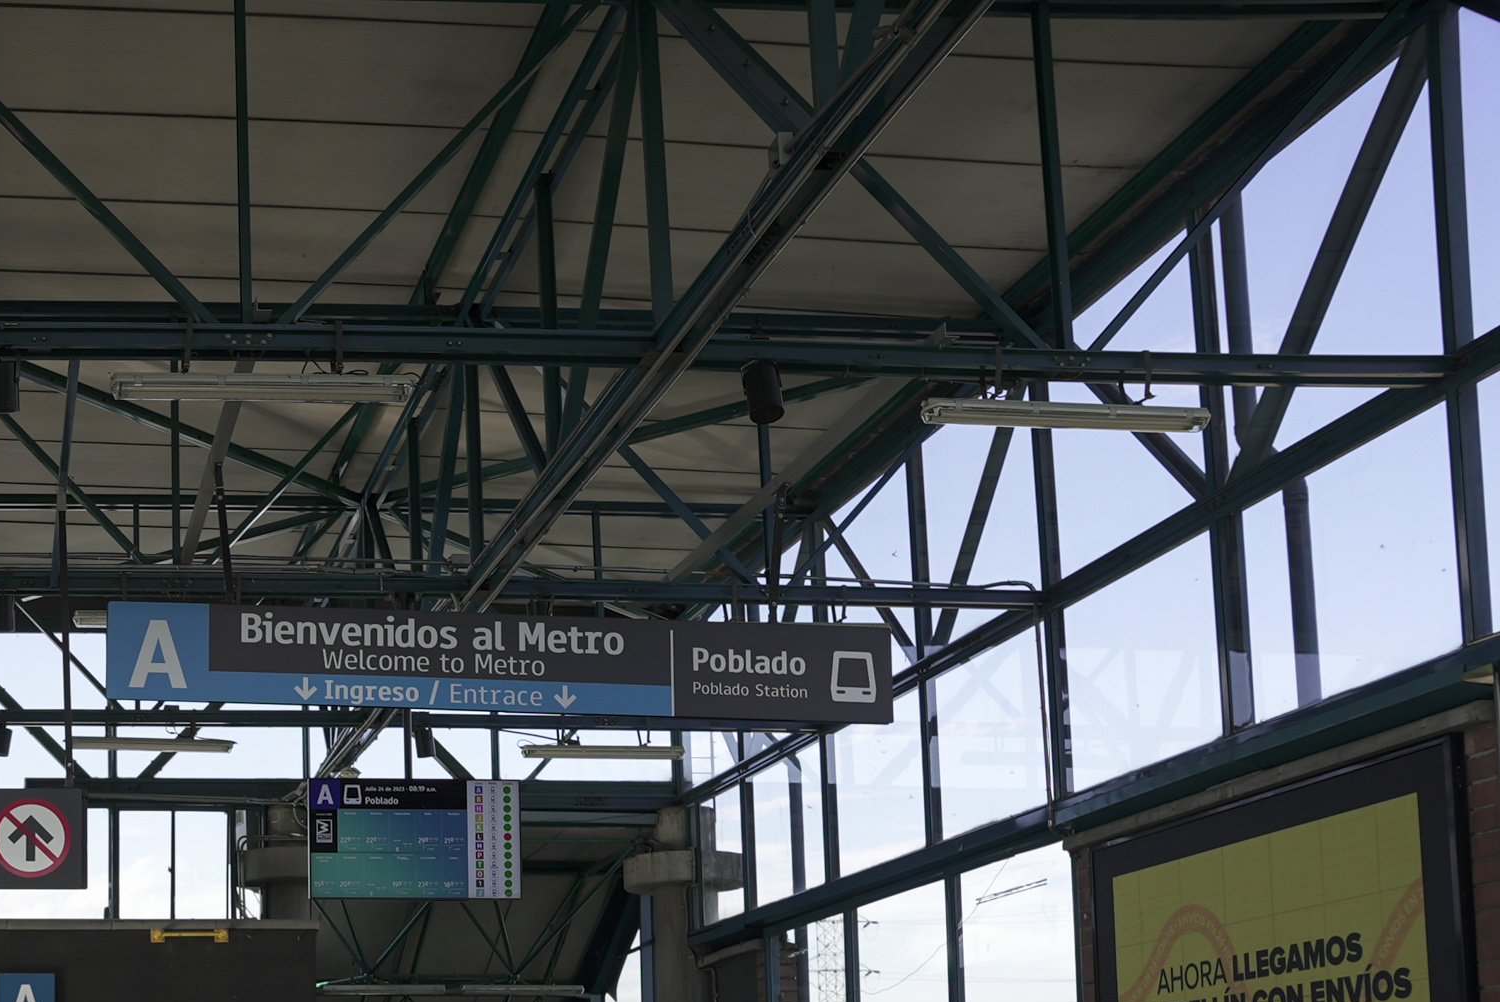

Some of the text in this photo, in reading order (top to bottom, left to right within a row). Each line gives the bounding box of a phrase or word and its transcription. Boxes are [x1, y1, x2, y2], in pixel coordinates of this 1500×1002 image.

[240, 612, 625, 655] Bienvenidos al Metro
[129, 620, 187, 688] A
[322, 649, 545, 677] Welcome to Metro
[692, 647, 806, 675] Poblado
[324, 680, 419, 705] Ingreso
[450, 683, 543, 706] Entrace
[692, 681, 807, 698] Poblado Station
[316, 784, 334, 805] A
[365, 796, 399, 805] Poblado
[1157, 958, 1227, 995] AHORA
[1232, 932, 1363, 982] LLEGAMOS
